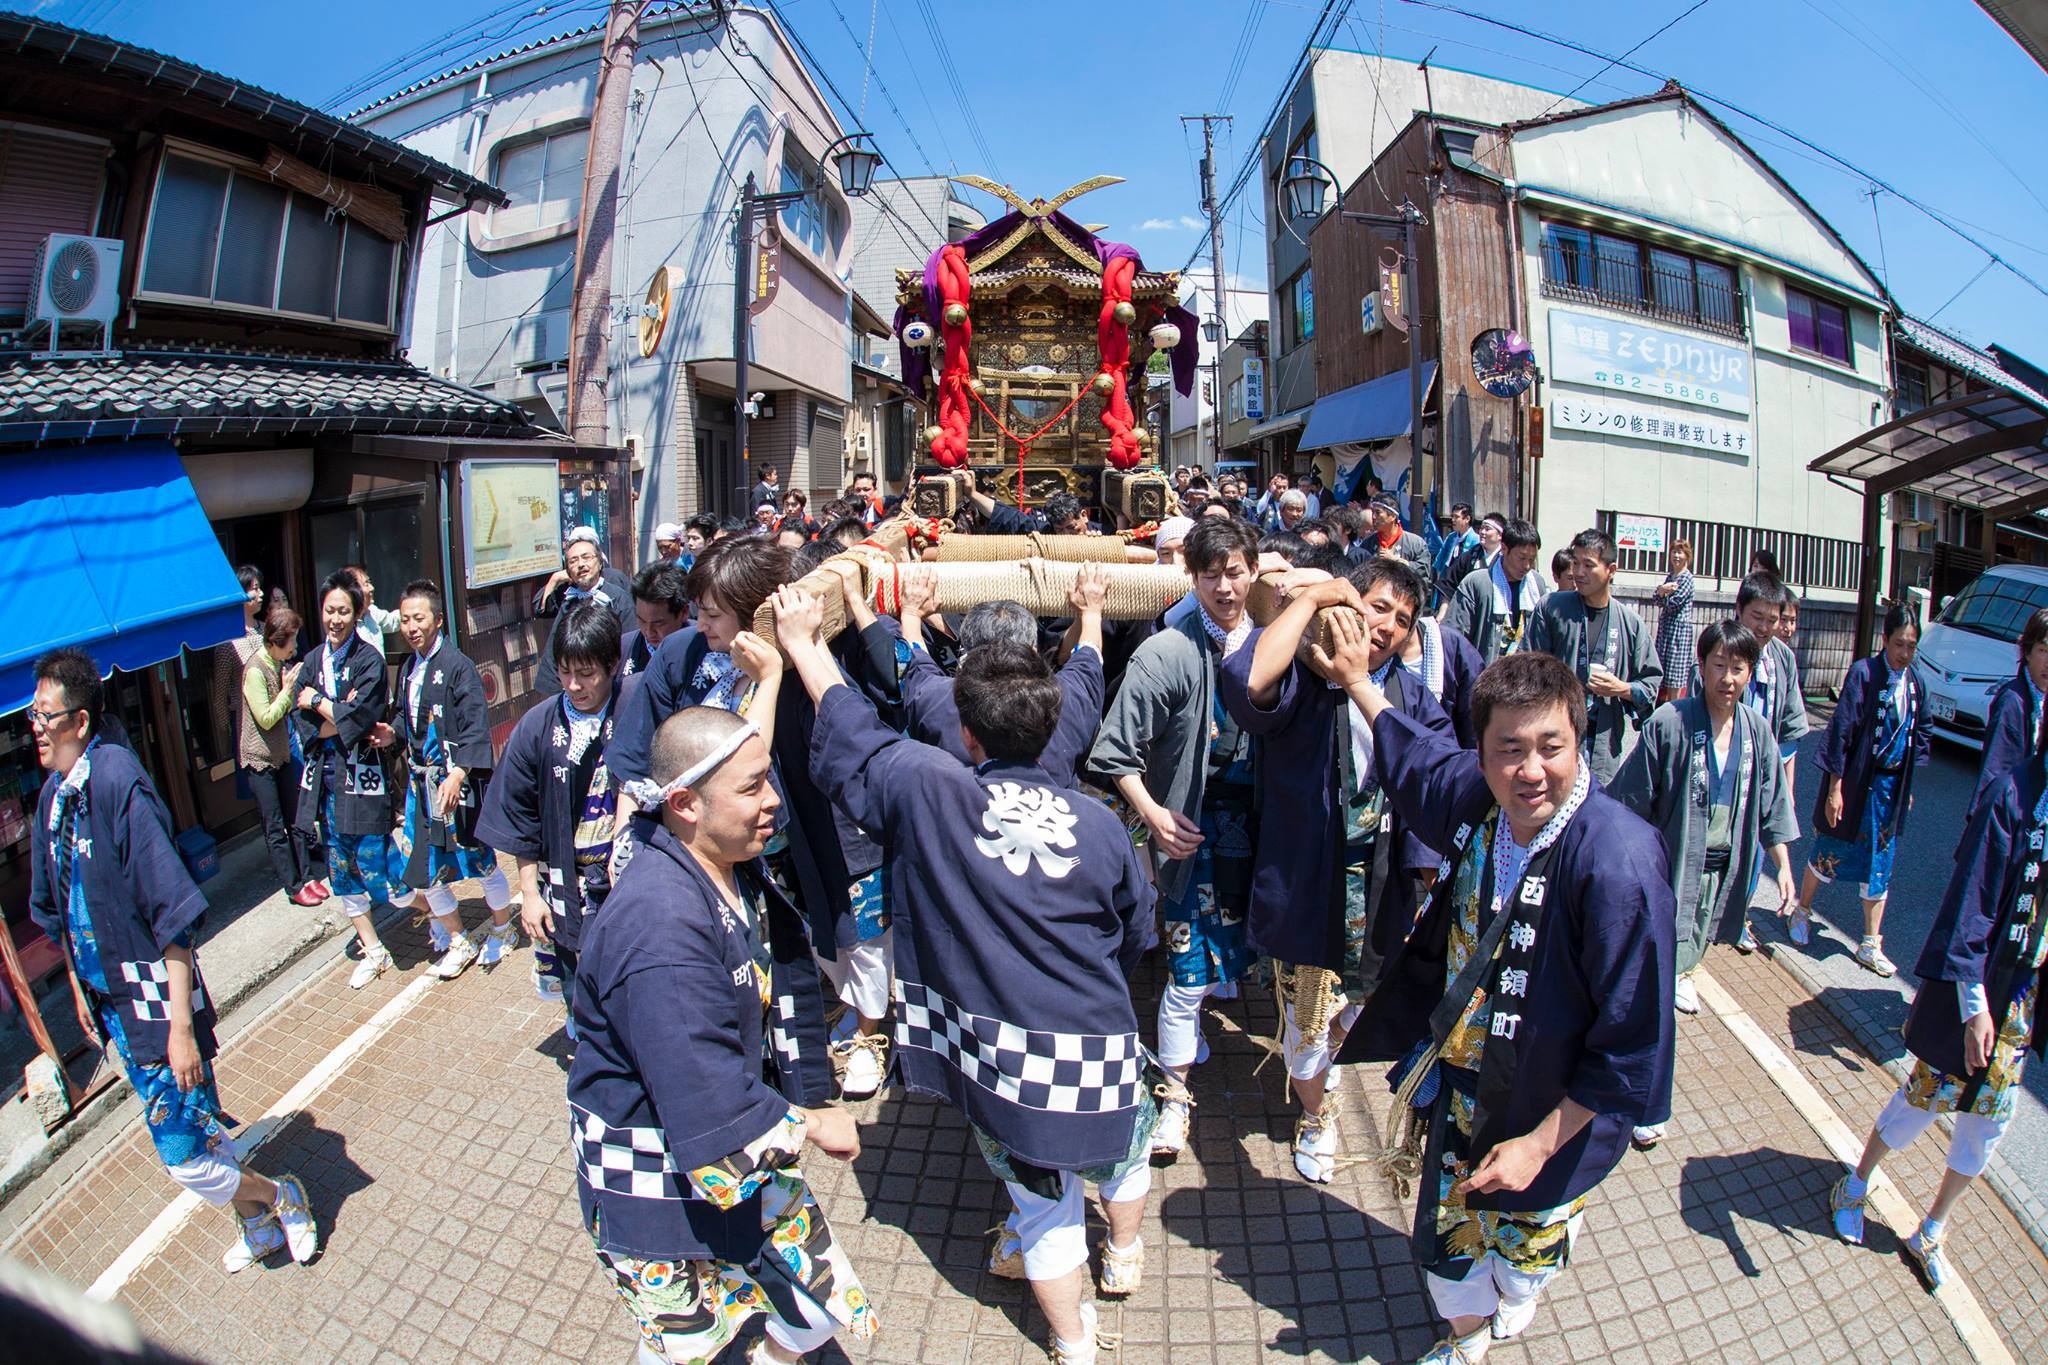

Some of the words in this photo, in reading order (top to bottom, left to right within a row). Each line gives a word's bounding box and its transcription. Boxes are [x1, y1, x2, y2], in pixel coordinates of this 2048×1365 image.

[1363, 296, 1375, 330] 米
[1561, 404, 1747, 450] ミシンの修理調整致します
[2008, 829, 2044, 942] 西神領町
[1491, 874, 1546, 1041] 西神領町
